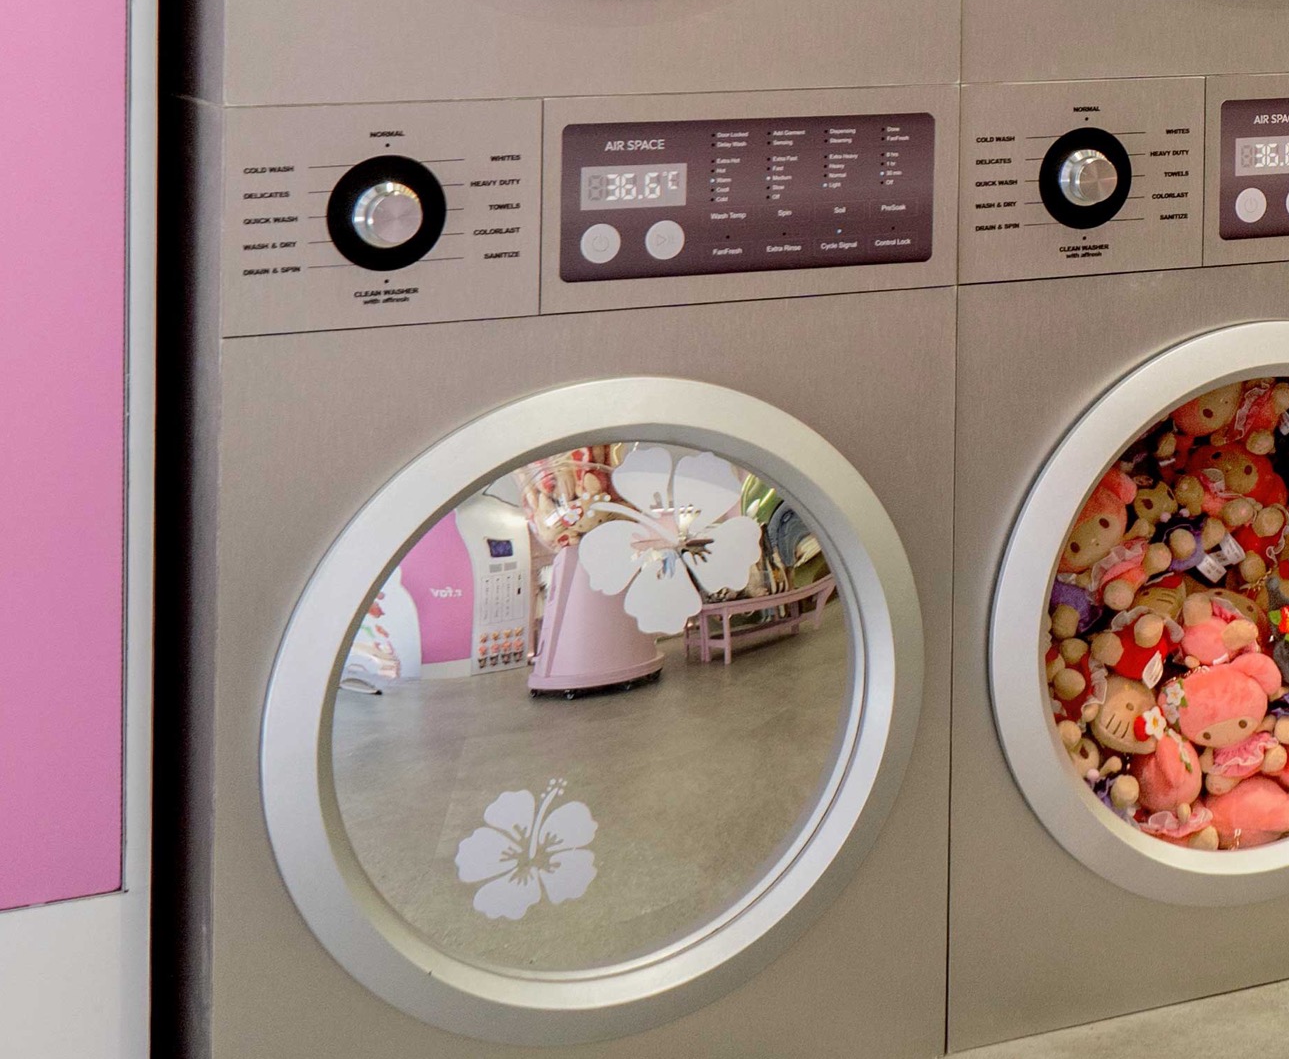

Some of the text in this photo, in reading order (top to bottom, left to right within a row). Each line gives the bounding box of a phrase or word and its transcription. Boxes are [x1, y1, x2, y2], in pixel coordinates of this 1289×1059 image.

[1253, 114, 1269, 125] AIR
[369, 130, 405, 138] NORMAL
[604, 138, 665, 152] AIR SPACE
[490, 154, 521, 162] WHITES
[975, 157, 1012, 165] DELICATES
[268, 165, 294, 173] WASH
[243, 191, 290, 200] DELICATES
[488, 202, 521, 210] TOWELS
[243, 215, 298, 225] QUICK WASH
[242, 242, 268, 250] WASH
[483, 251, 520, 259] SANITIZE
[243, 268, 269, 276] DRAIN
[353, 287, 419, 298] CLEAN WASHER
